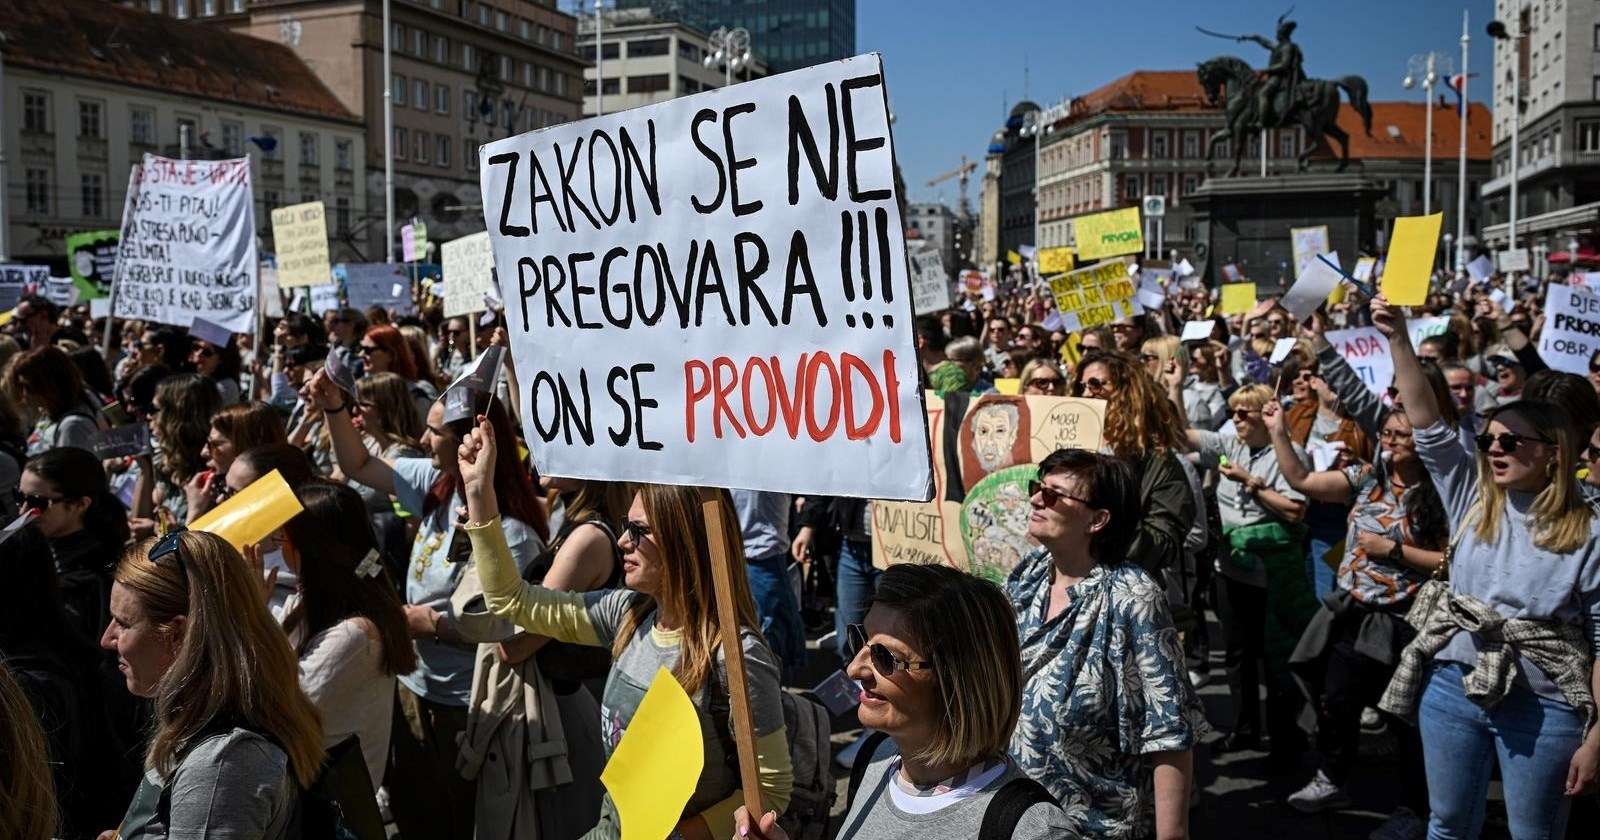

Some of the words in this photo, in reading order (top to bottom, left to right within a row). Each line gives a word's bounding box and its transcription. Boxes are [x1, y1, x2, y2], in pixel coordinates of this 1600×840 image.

[488, 119, 661, 238] ZAKON
[691, 102, 763, 217] SE
[788, 74, 892, 206] NE
[518, 230, 828, 333] PREGOVARA
[841, 207, 894, 330] !!!
[1333, 335, 1384, 358] ADA
[532, 367, 595, 446] ON
[607, 363, 663, 451] SE
[684, 349, 901, 444] PROVODI
[1050, 413, 1079, 426] MOGU
[1055, 426, 1077, 441] JOŠ
